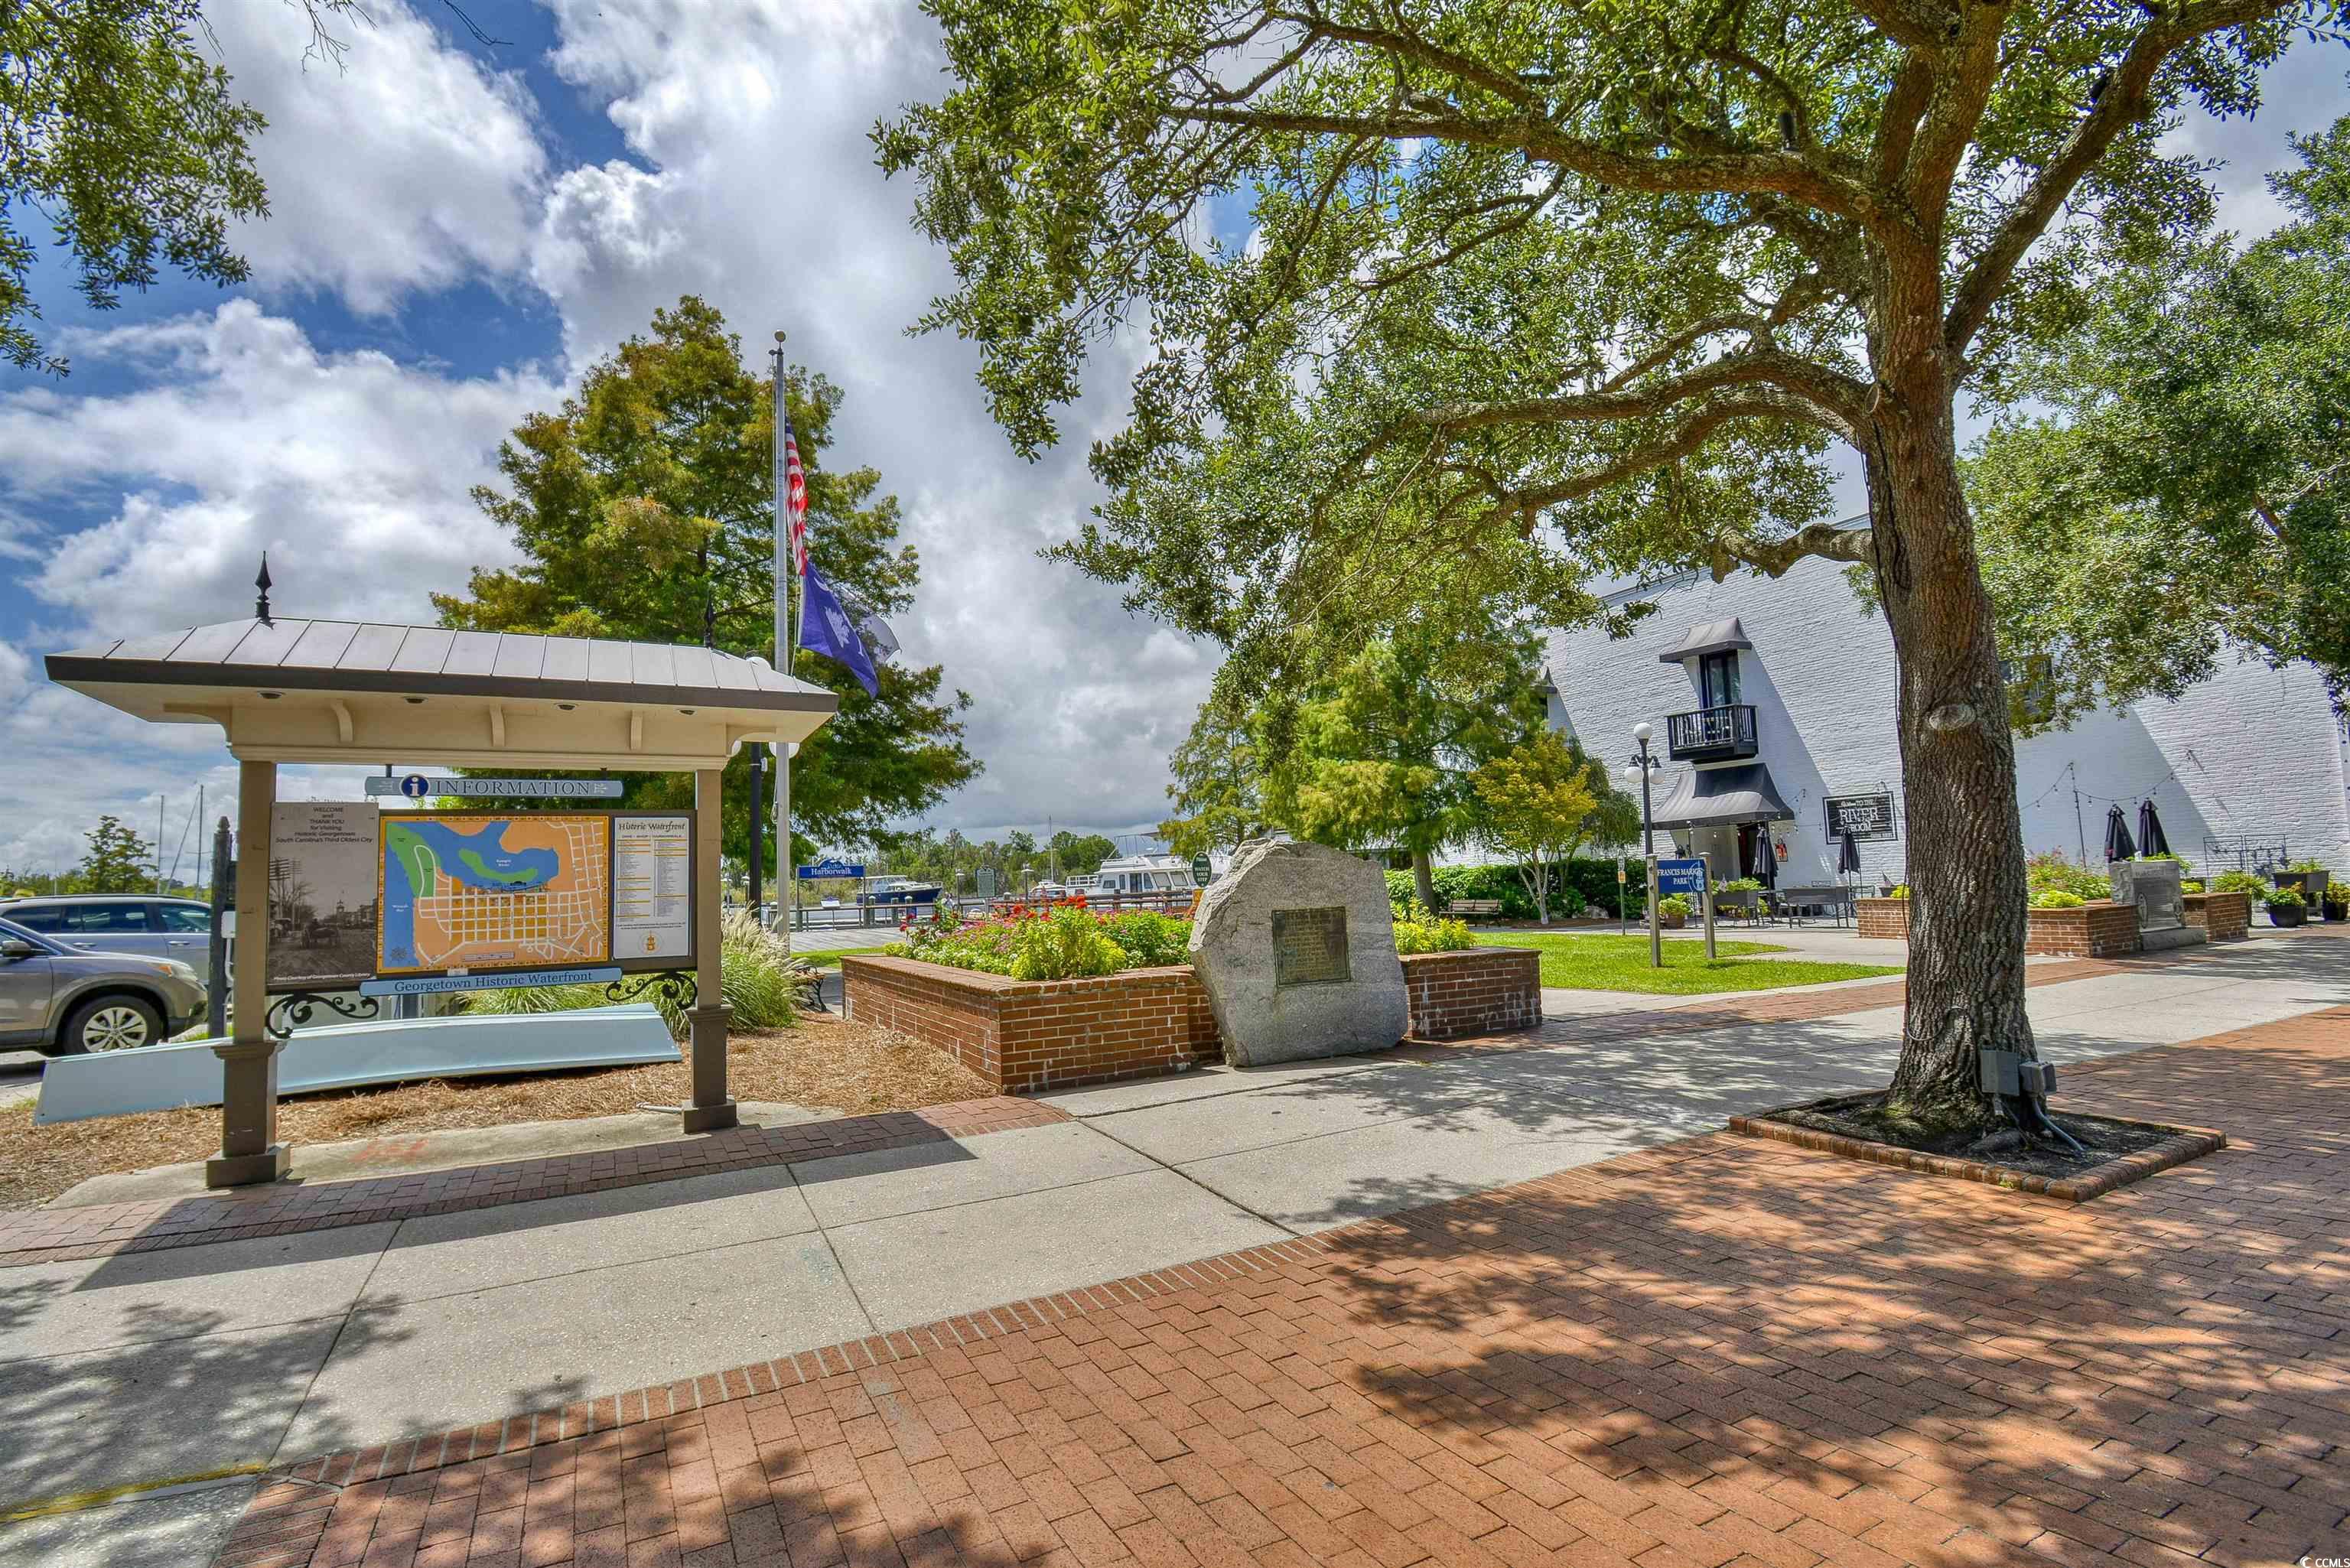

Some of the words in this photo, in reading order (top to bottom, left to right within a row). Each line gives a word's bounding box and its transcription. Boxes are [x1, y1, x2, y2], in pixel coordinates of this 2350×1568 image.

[436, 779, 590, 795] INFORMATION
[1839, 808, 1880, 822] RIVER
[619, 821, 646, 831] Historic
[648, 820, 685, 832] Waterfront
[1850, 821, 1872, 832] ROOM
[811, 867, 852, 876] Harborwalk
[1657, 868, 1681, 877] FRANCIS
[1673, 877, 1689, 885] PARK
[394, 978, 471, 994] Georgetown
[475, 974, 524, 987] Historic
[529, 971, 593, 986] Waterfront
